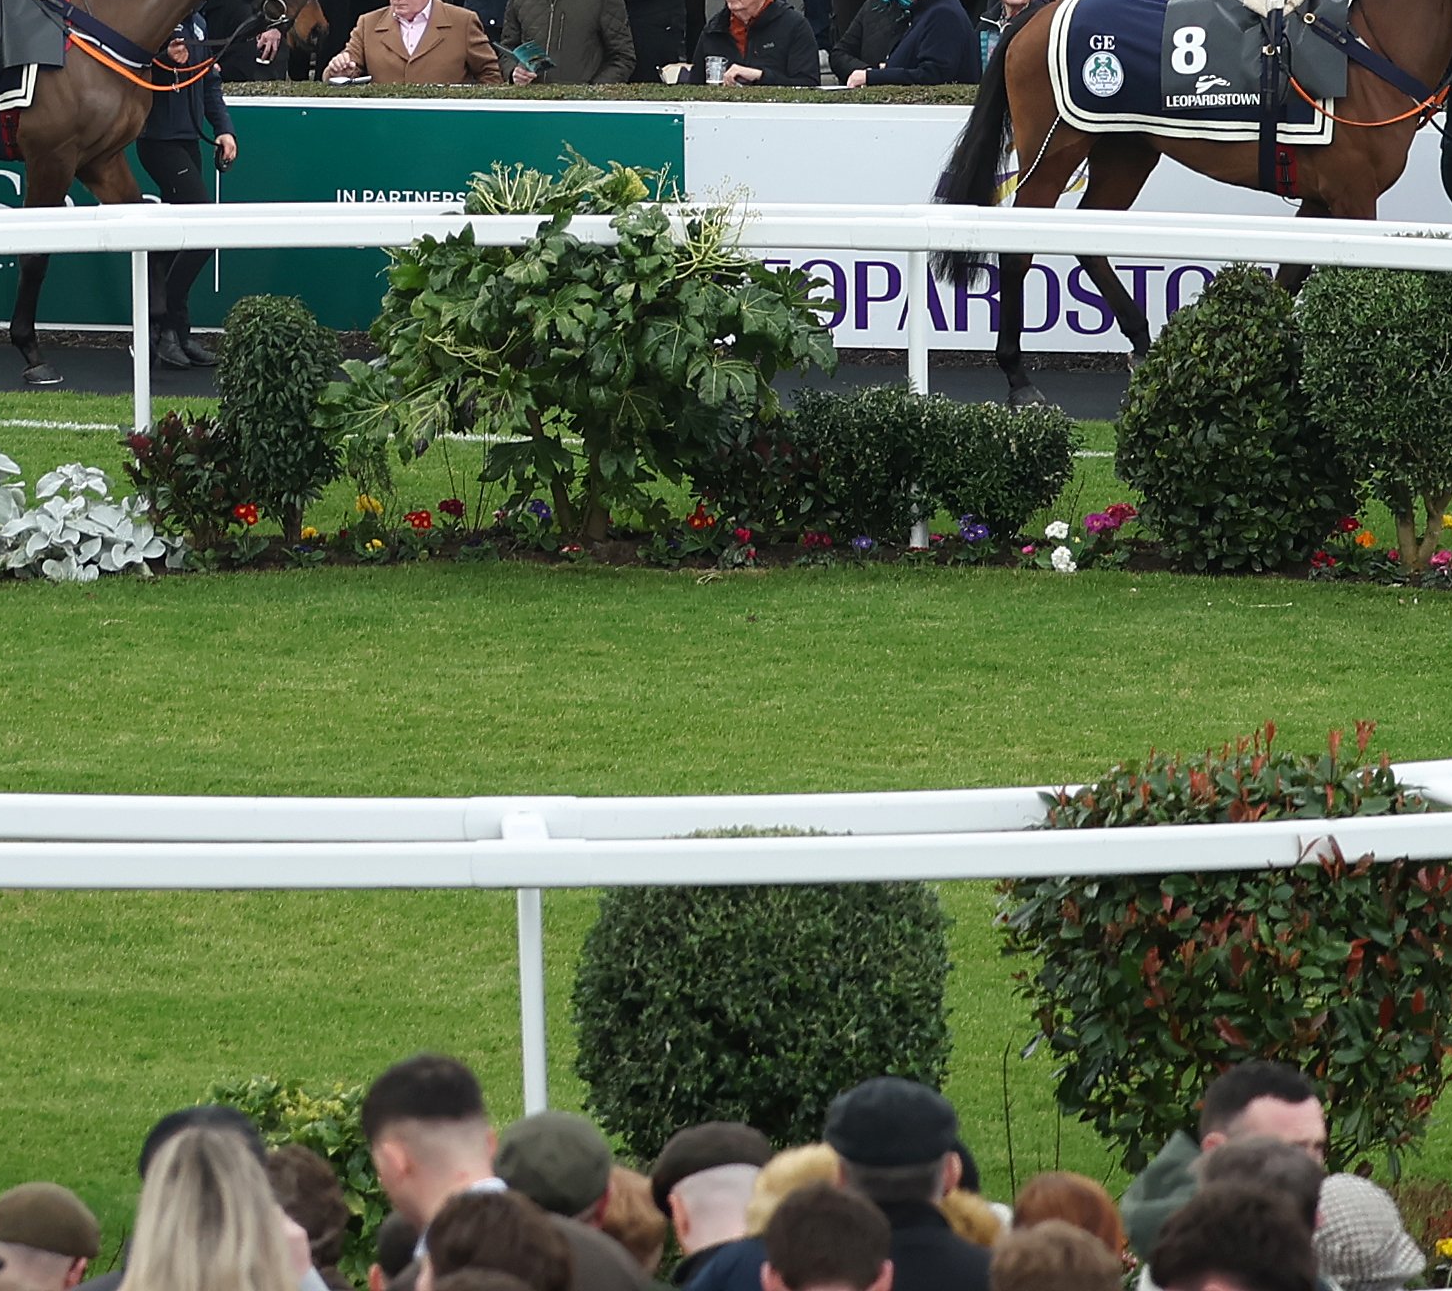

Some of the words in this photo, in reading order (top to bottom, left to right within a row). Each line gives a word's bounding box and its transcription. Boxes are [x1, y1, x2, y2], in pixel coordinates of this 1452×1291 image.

[1089, 34, 1116, 51] GE
[1171, 26, 1207, 75] 8
[1165, 93, 1261, 109] LEOPARDSTOWN
[336, 189, 357, 203] IN
